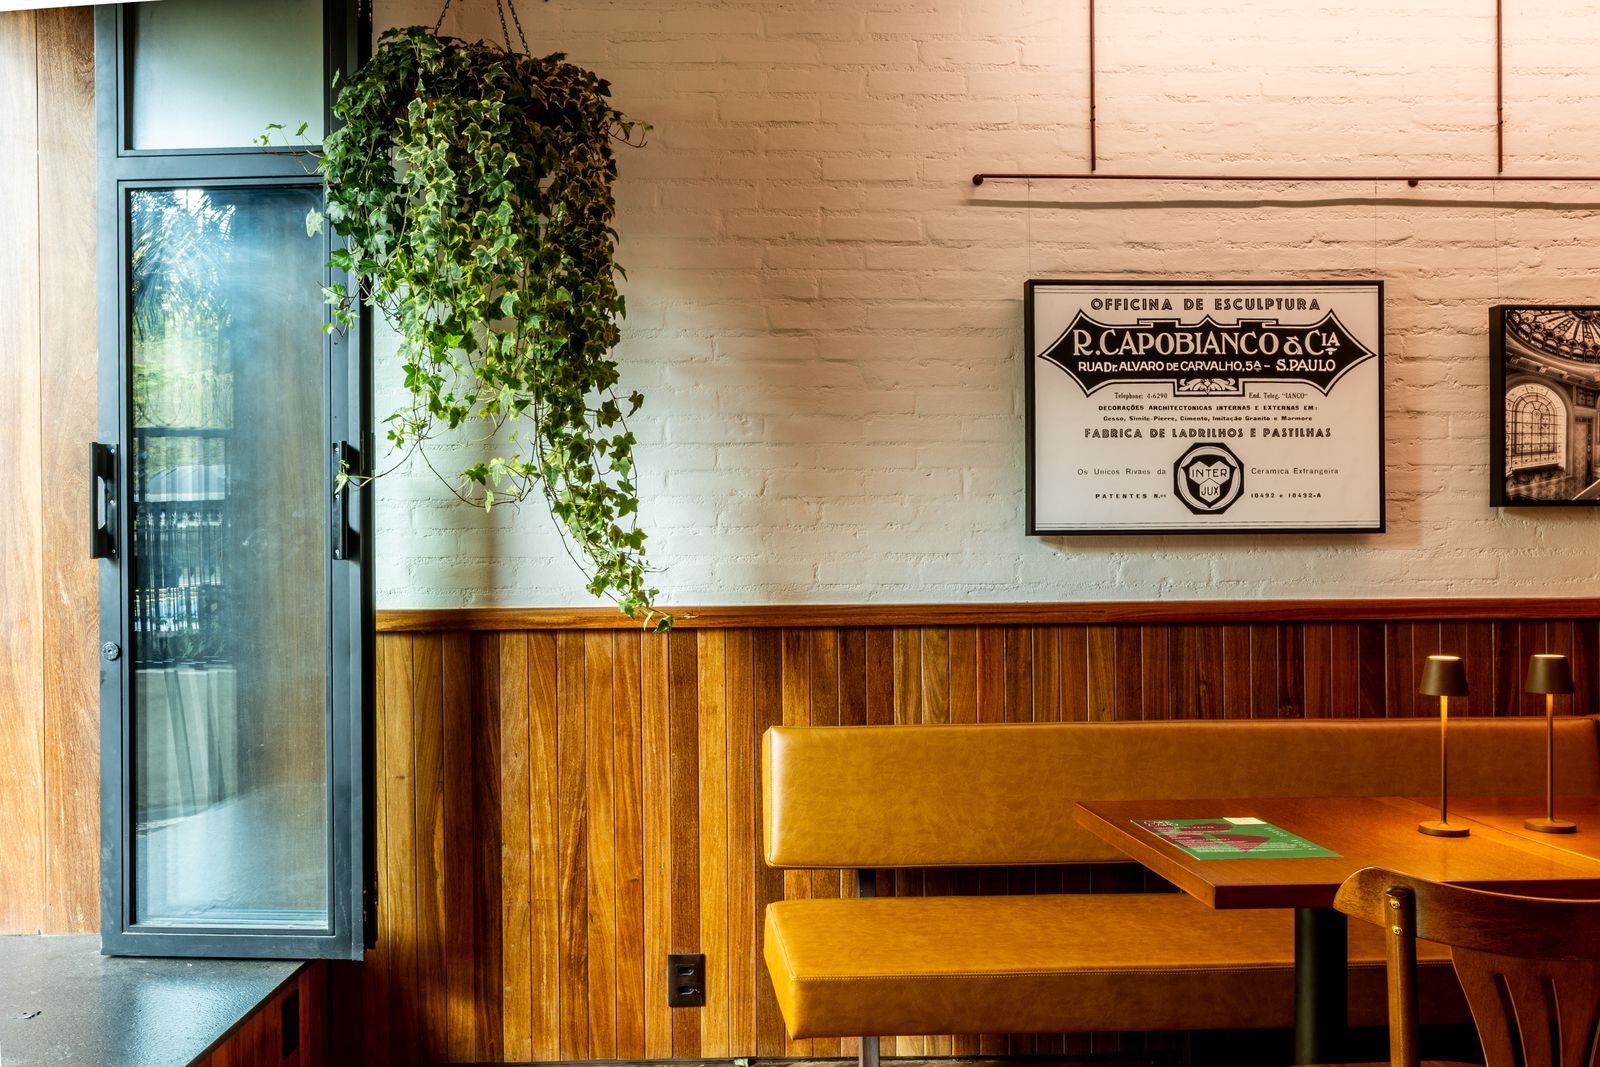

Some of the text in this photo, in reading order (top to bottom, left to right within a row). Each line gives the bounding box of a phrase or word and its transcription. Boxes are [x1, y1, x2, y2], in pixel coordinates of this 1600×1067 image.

[1091, 298, 1320, 310] OFFICINA DE ESCULPTURA
[1079, 362, 1102, 371] RUA
[1104, 362, 1117, 372] Dr.
[1119, 361, 1164, 371] ALVARO
[1166, 363, 1179, 371] DE
[1085, 428, 1331, 438] FABRICA DE LADRILHOS E PASTILHAS
[1191, 468, 1228, 478] INTER
[1201, 486, 1218, 496] JUX
